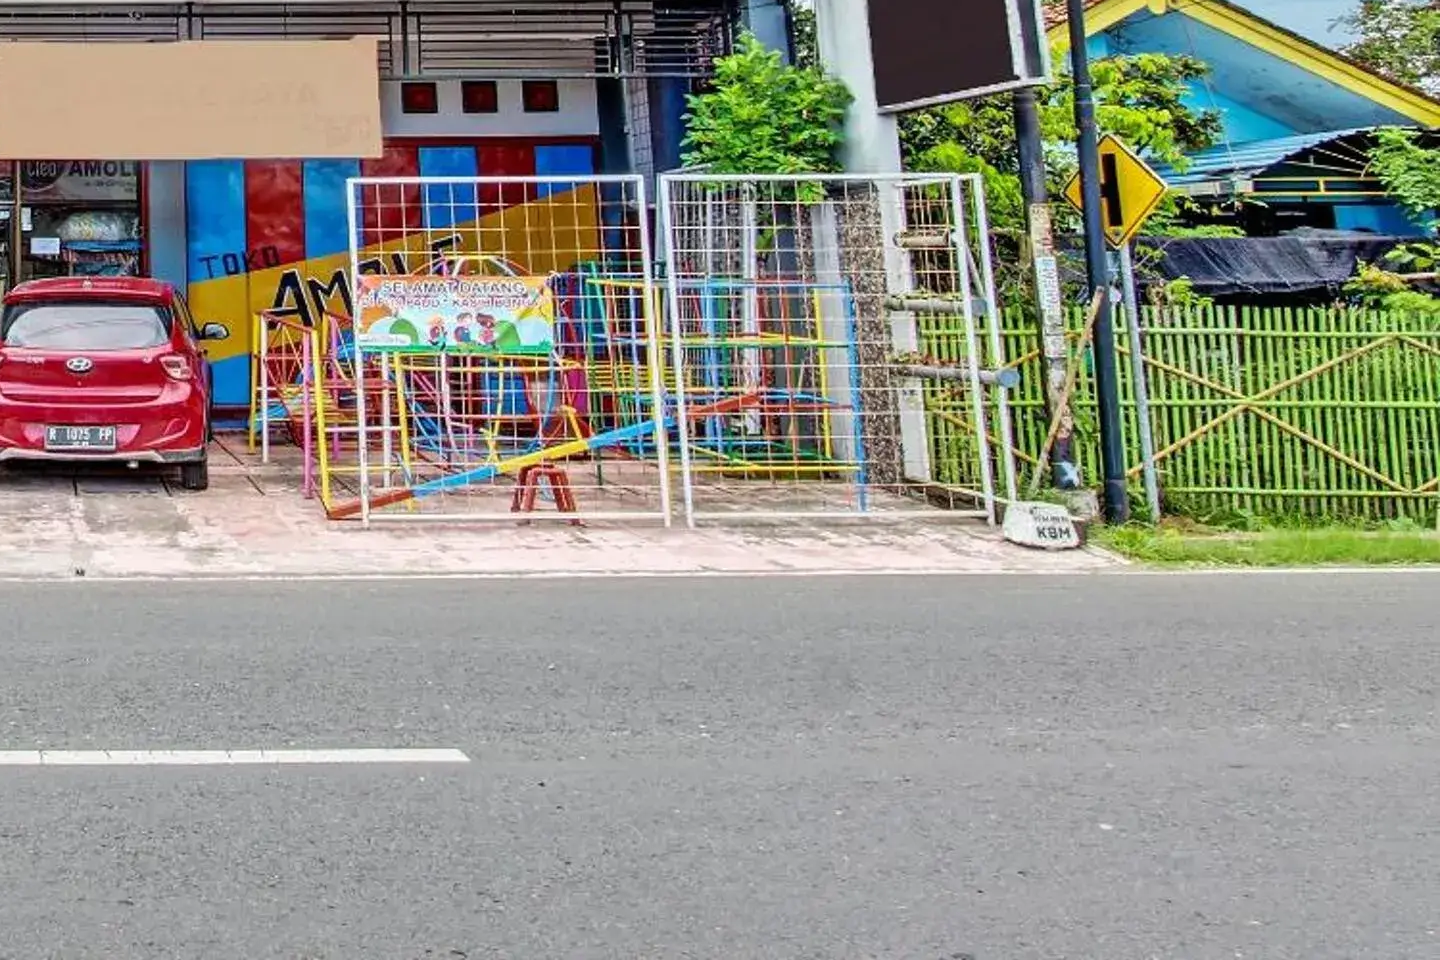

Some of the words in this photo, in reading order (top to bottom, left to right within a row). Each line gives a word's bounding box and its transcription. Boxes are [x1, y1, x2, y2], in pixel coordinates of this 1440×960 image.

[198, 244, 280, 280] TOKO
[383, 281, 457, 294] SELAMAT
[460, 281, 526, 294] DATANG
[49, 427, 57, 440] R
